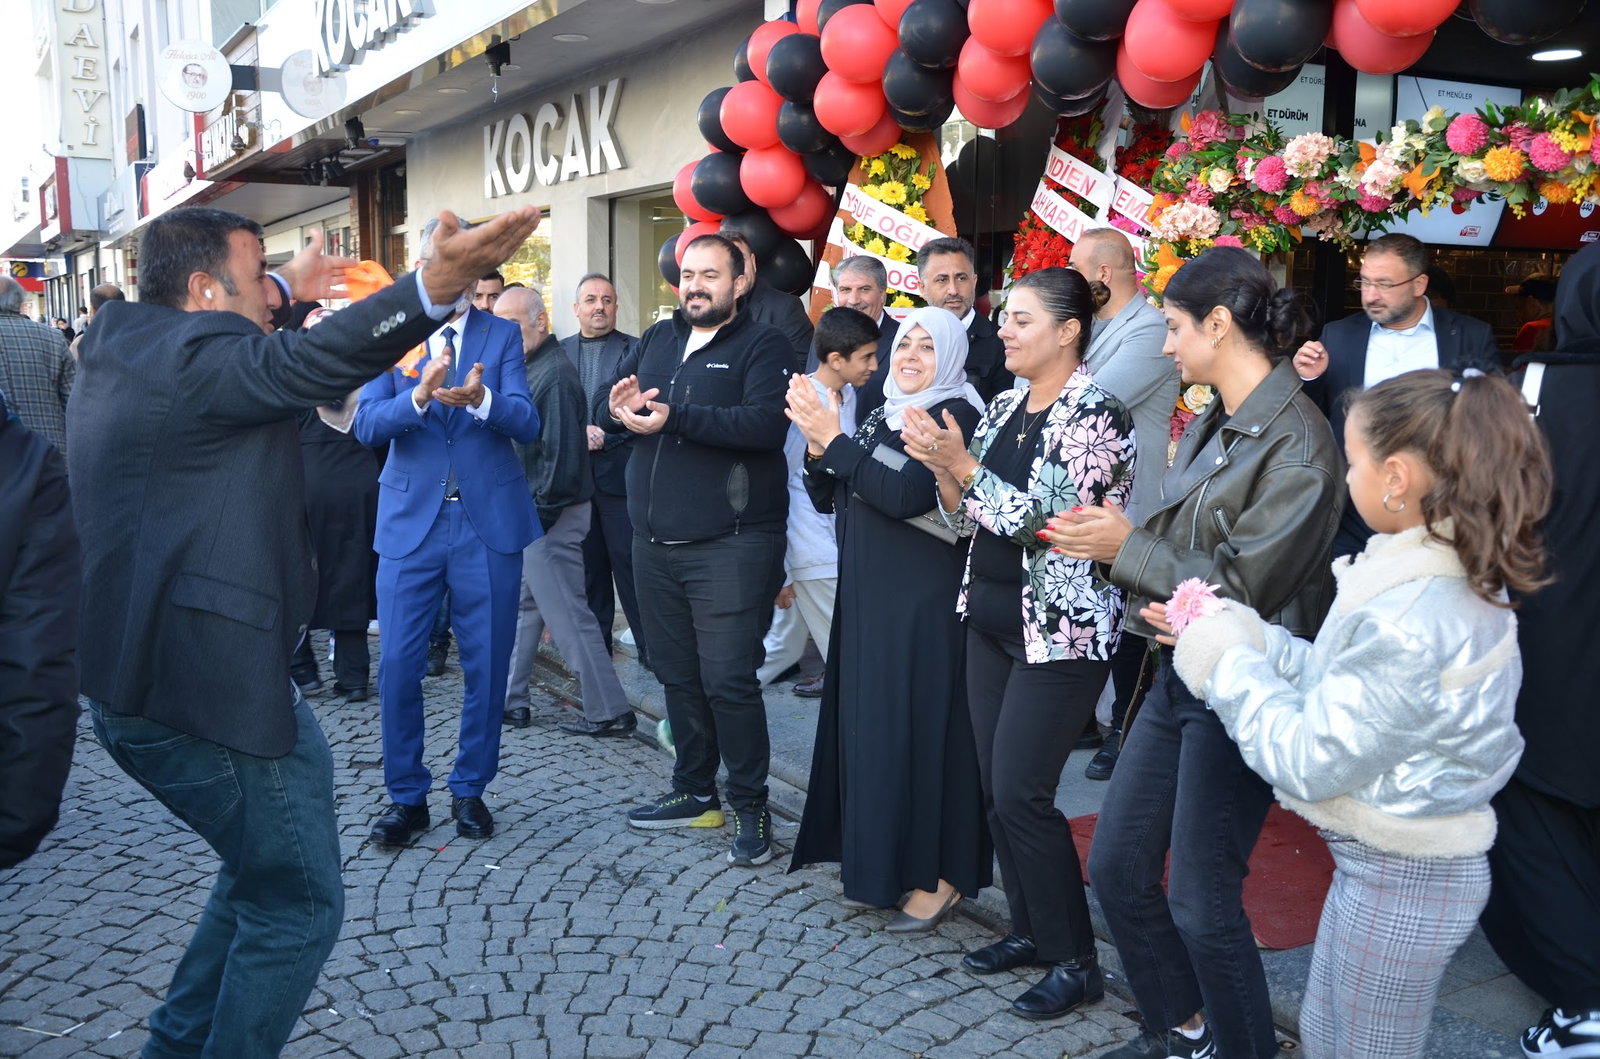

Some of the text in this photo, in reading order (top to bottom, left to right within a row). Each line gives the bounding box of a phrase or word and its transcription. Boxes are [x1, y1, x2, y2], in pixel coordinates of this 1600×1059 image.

[1438, 89, 1473, 100] ET MENÜLER
[1267, 108, 1309, 122] ET DÜRÜM
